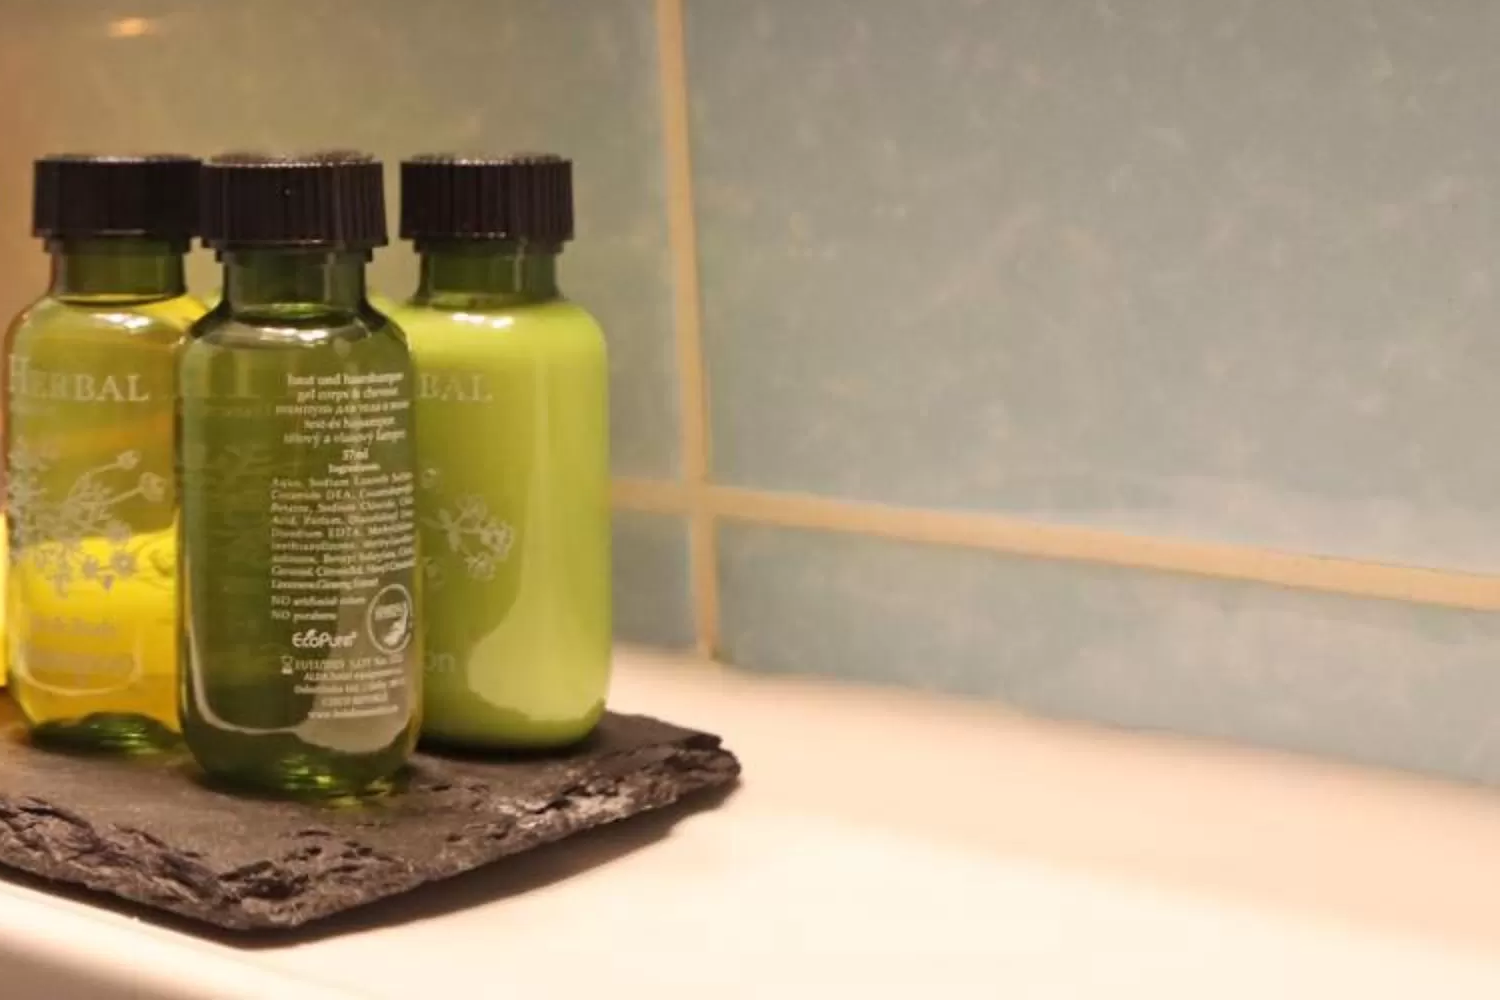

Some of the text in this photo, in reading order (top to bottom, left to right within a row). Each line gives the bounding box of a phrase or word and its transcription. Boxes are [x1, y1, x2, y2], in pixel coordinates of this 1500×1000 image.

[8, 355, 150, 402] HERBAL
[419, 372, 493, 402] BAL
[270, 595, 291, 606] NO
[270, 609, 291, 620] NO
